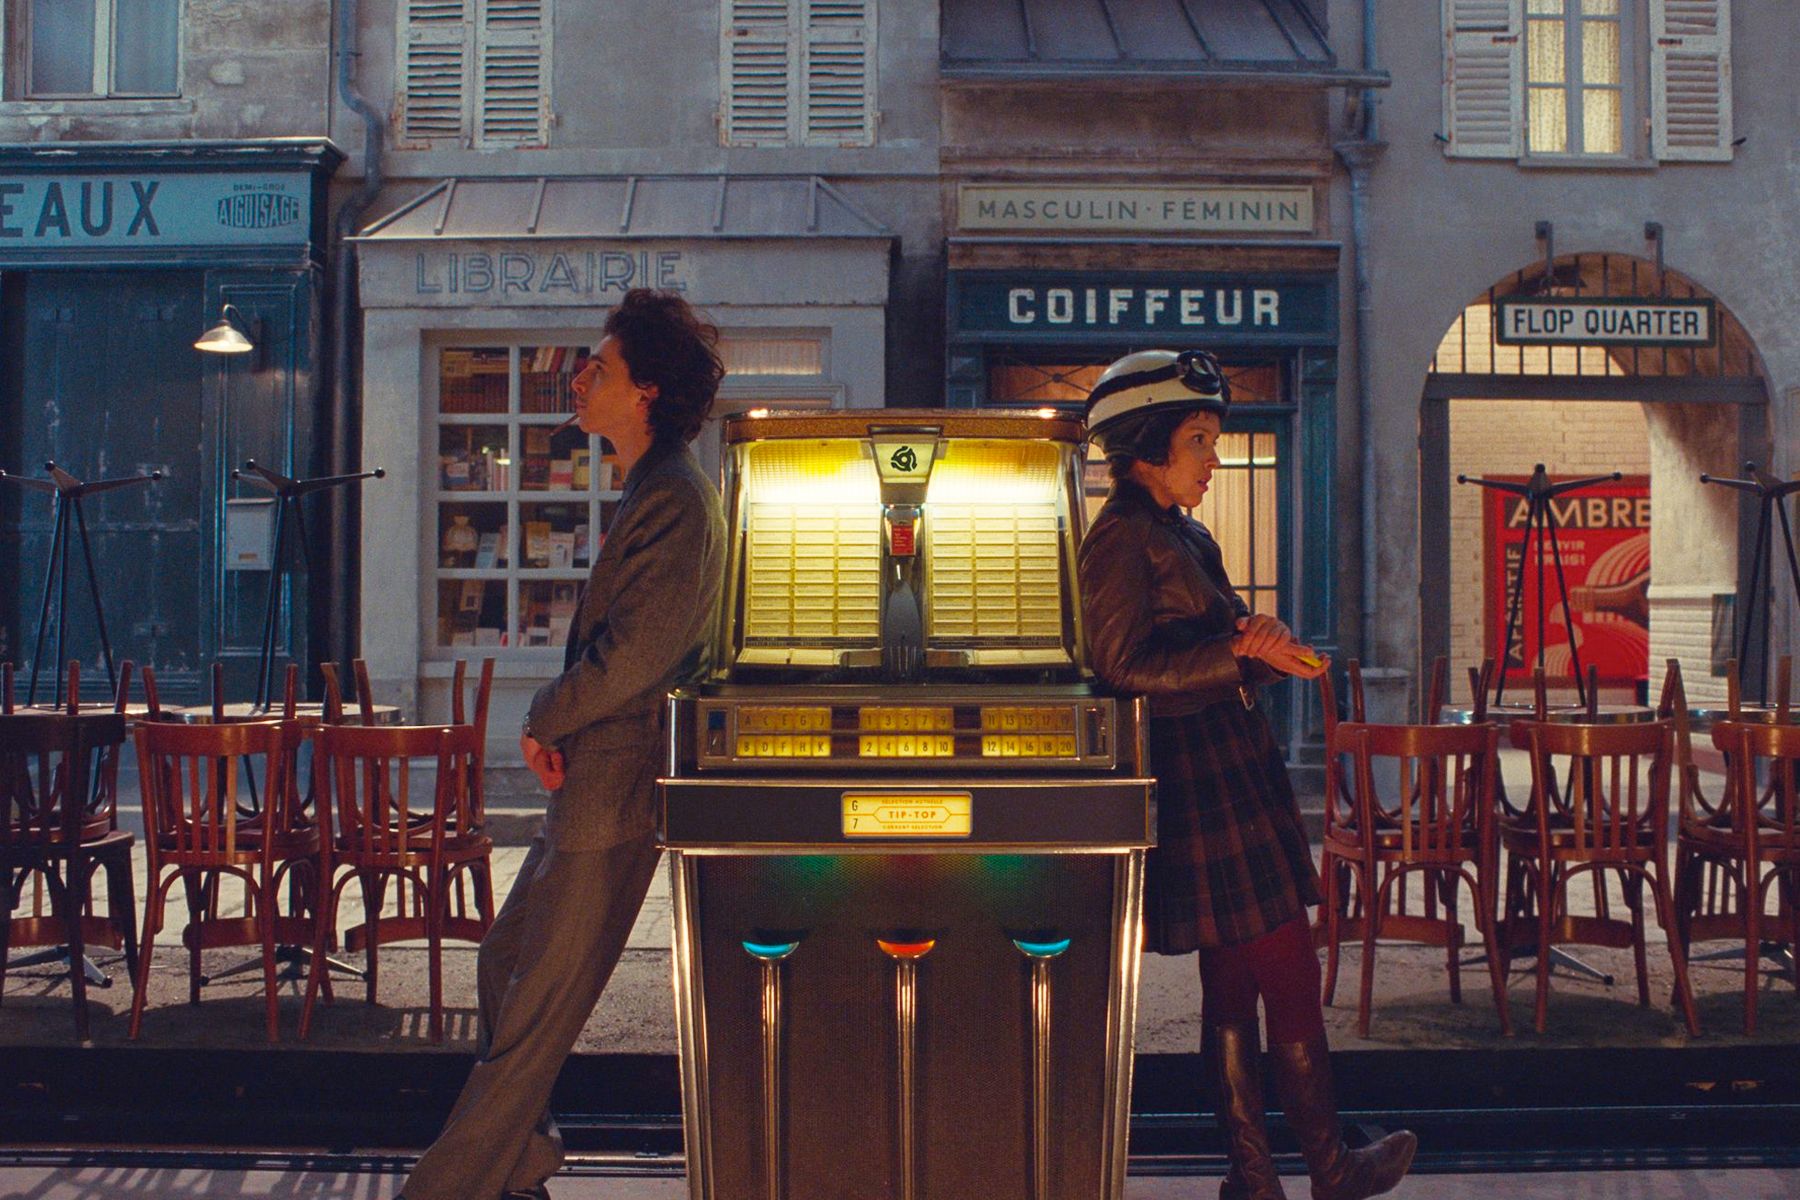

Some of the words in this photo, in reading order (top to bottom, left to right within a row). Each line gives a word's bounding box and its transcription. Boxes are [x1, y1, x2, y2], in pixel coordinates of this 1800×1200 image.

[0, 181, 160, 238] EAUX
[218, 193, 299, 228] AIGUISAGE
[978, 200, 1137, 220] MASCULIN
[1162, 197, 1299, 221] FÉMININ
[415, 252, 687, 294] LIBRAIRIE
[1008, 288, 1280, 326] COIFFEUR
[1513, 308, 1573, 334] FLOP
[1584, 309, 1699, 336] QUARTER
[988, 715, 995, 726] 11
[1006, 715, 1015, 726] 13
[1024, 715, 1033, 726] 15
[939, 742, 948, 752] 10
[987, 742, 996, 752] 12
[1006, 742, 1015, 752] 14
[1025, 742, 1034, 752] 16
[1043, 742, 1052, 752] 18
[1060, 742, 1072, 752] 20
[852, 800, 858, 811] G
[853, 818, 858, 830] 7
[888, 811, 937, 819] TIP-TOP
